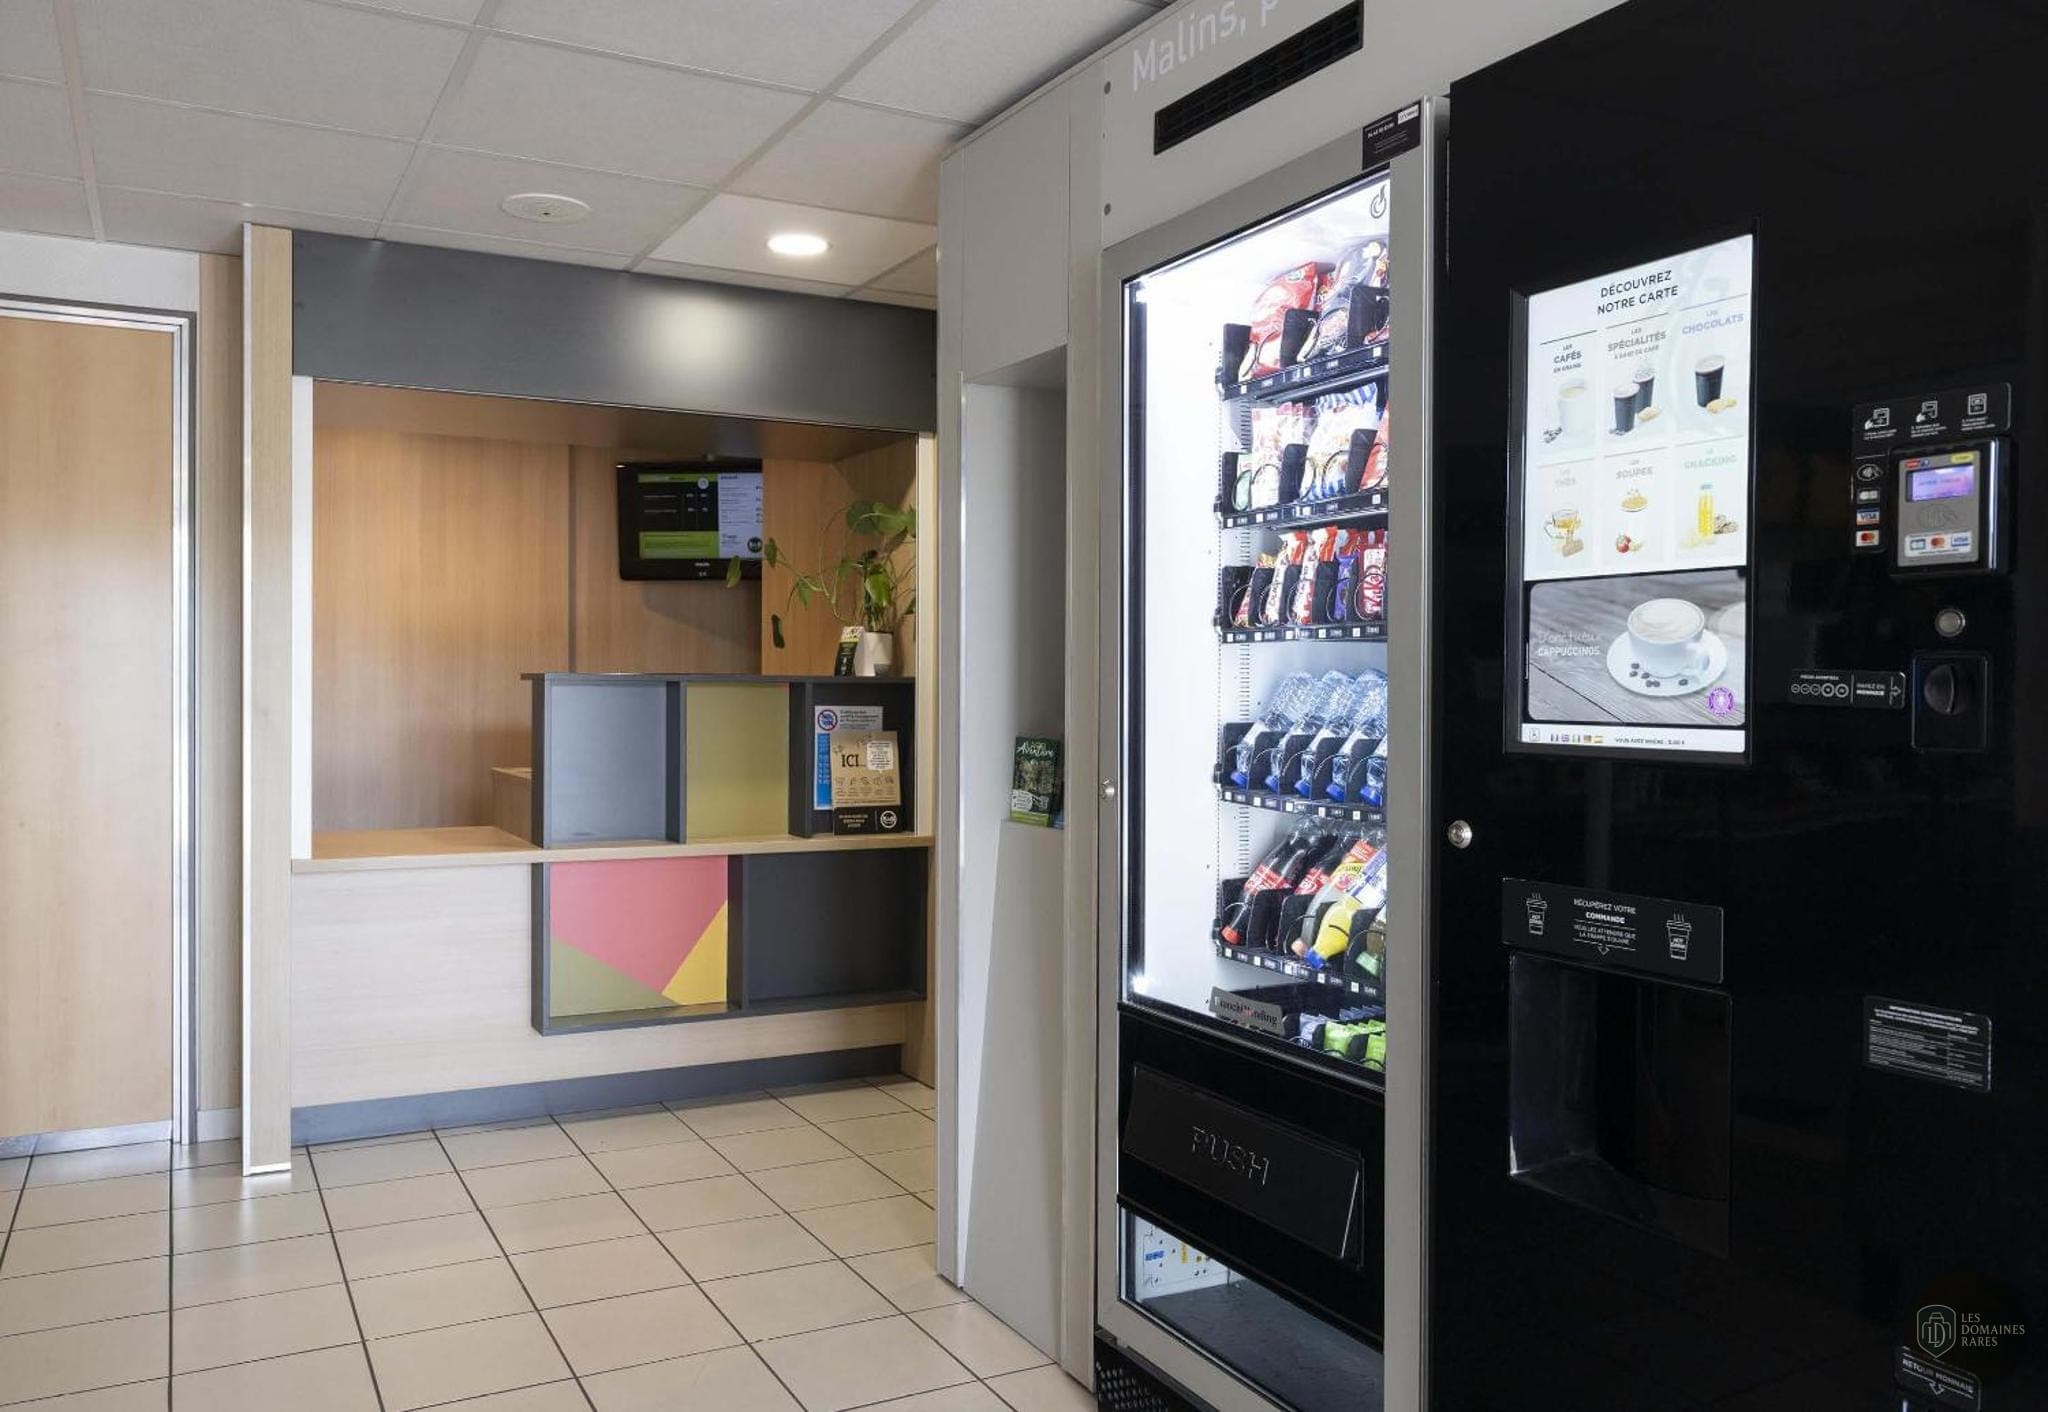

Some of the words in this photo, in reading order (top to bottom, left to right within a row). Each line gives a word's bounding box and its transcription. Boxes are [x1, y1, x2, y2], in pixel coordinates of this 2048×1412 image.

[1132, 0, 1247, 91] Malins,
[1600, 269, 1672, 298] DÉCOUVREZ
[1597, 296, 1636, 315] NOTRE
[1639, 285, 1679, 304] CARTE
[1681, 312, 1745, 335] CHOCOLATS
[1607, 330, 1667, 352] SPÉCIALITÉS
[1553, 350, 1582, 364] CAFÉS
[1538, 646, 1600, 657] CAPPUCCINOS
[1585, 911, 1626, 924] COMMANDE
[1613, 904, 1636, 914] VOTRE
[1191, 1125, 1270, 1185] PUSH
[1902, 1358, 1935, 1378] RETOUR
[1935, 1371, 1974, 1394] MONNAIE
